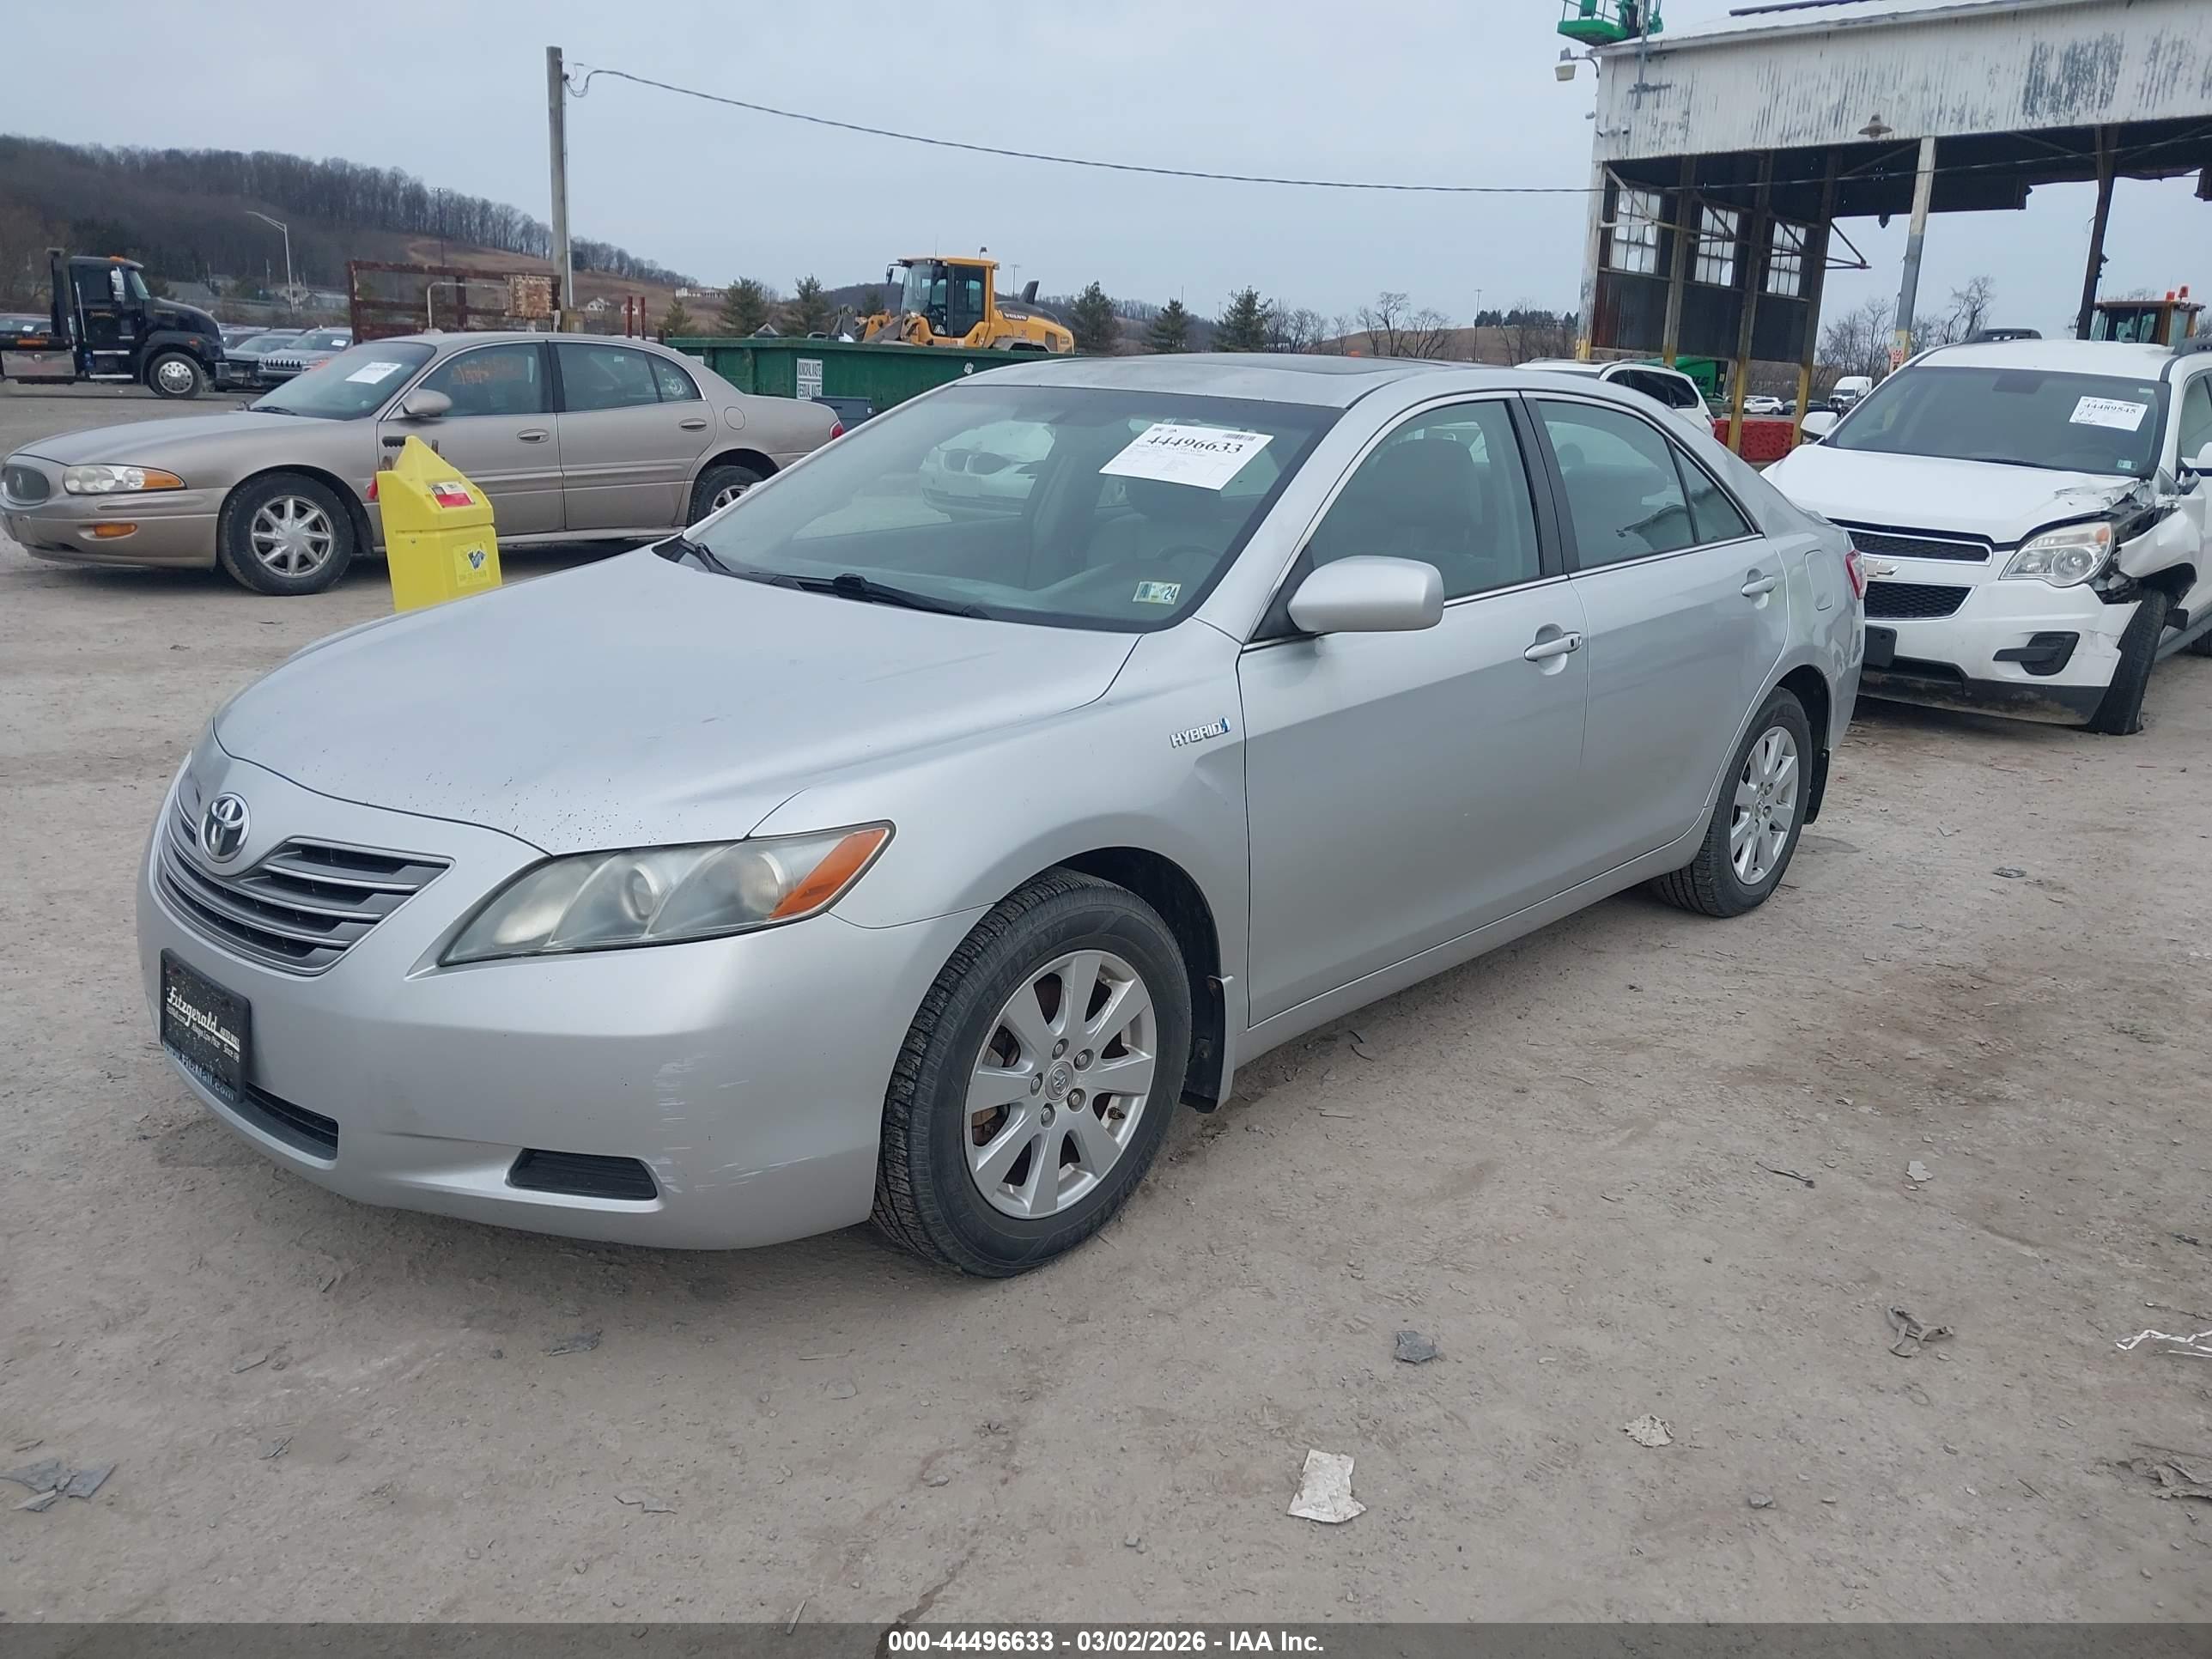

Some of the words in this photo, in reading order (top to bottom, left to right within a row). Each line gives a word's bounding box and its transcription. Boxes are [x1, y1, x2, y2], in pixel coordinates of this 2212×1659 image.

[798, 362, 811, 377] MUNICIPAL
[812, 362, 821, 378] WASTE
[1146, 435, 1243, 454] 44496633
[1164, 586, 1178, 600] 24
[1169, 721, 1224, 749] HYBRID
[166, 985, 218, 1033] Fitzgerald
